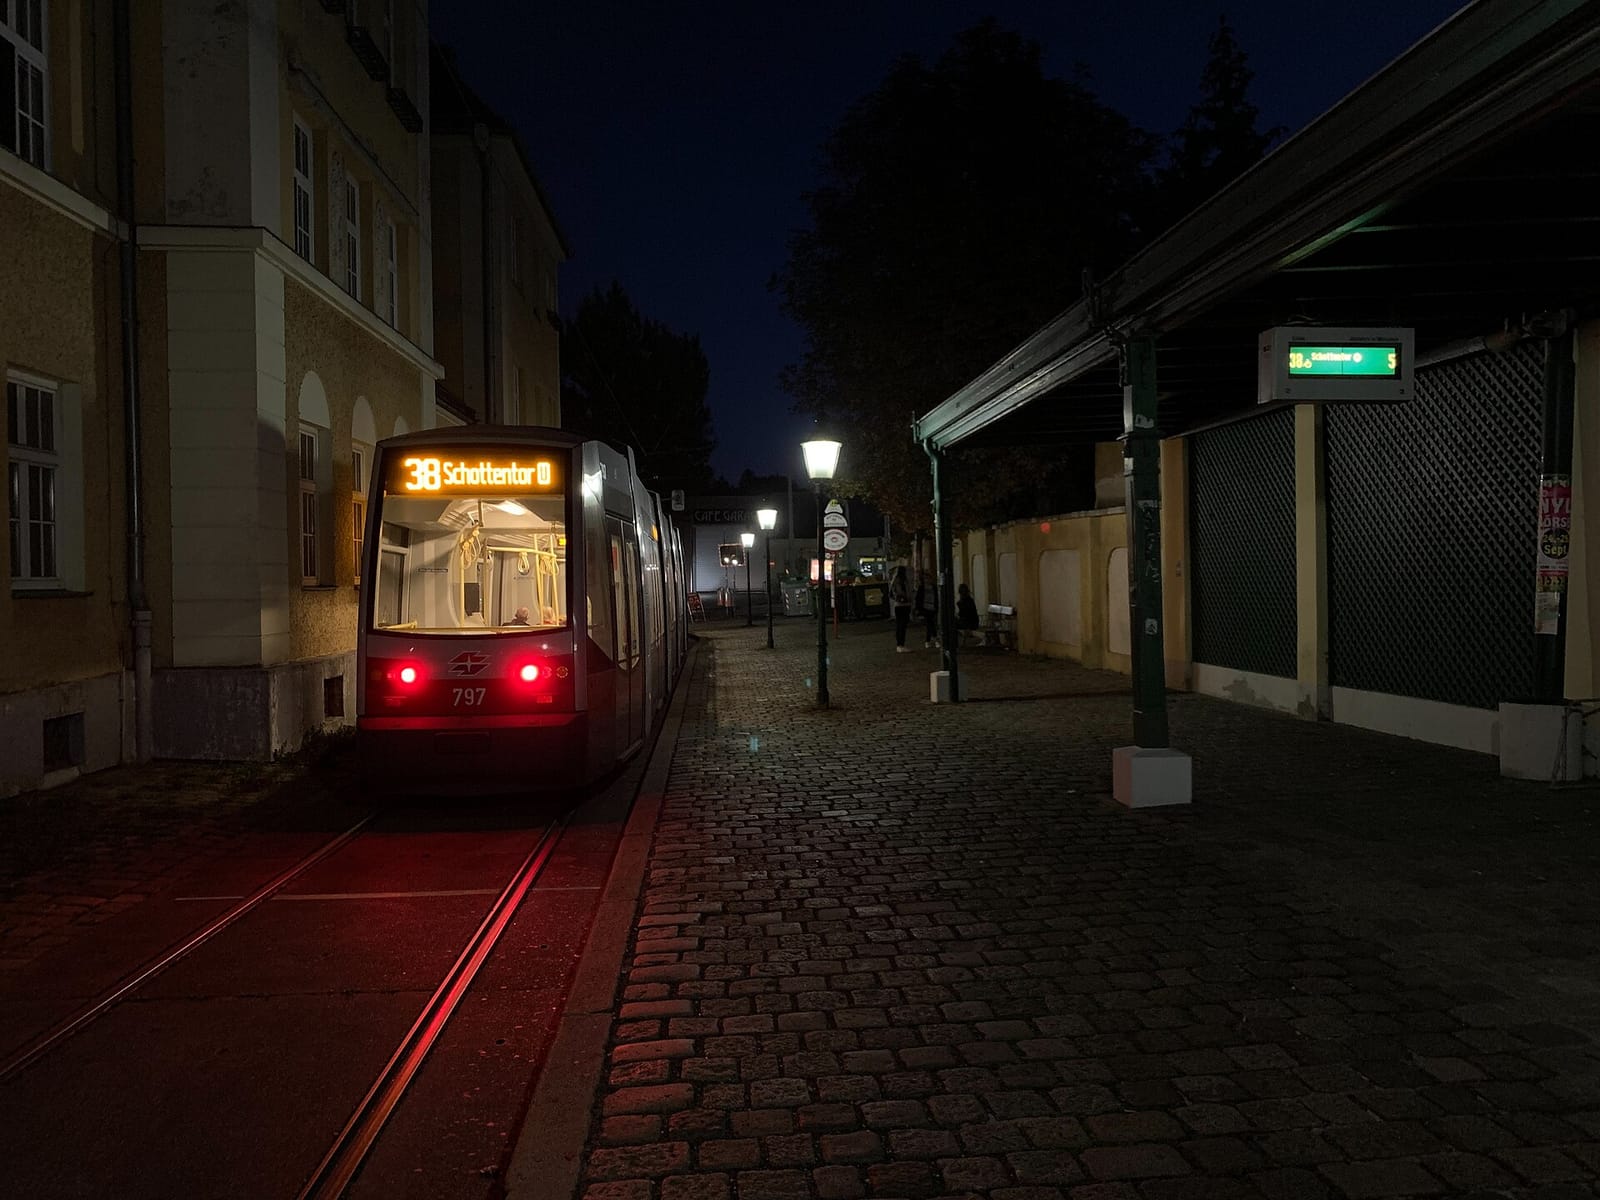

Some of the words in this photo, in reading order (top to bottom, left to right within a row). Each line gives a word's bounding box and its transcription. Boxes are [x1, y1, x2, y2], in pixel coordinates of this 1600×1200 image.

[1387, 353, 1396, 369] 5
[404, 458, 441, 490] 38
[442, 461, 535, 485] Schottentor
[453, 687, 486, 706] 797
